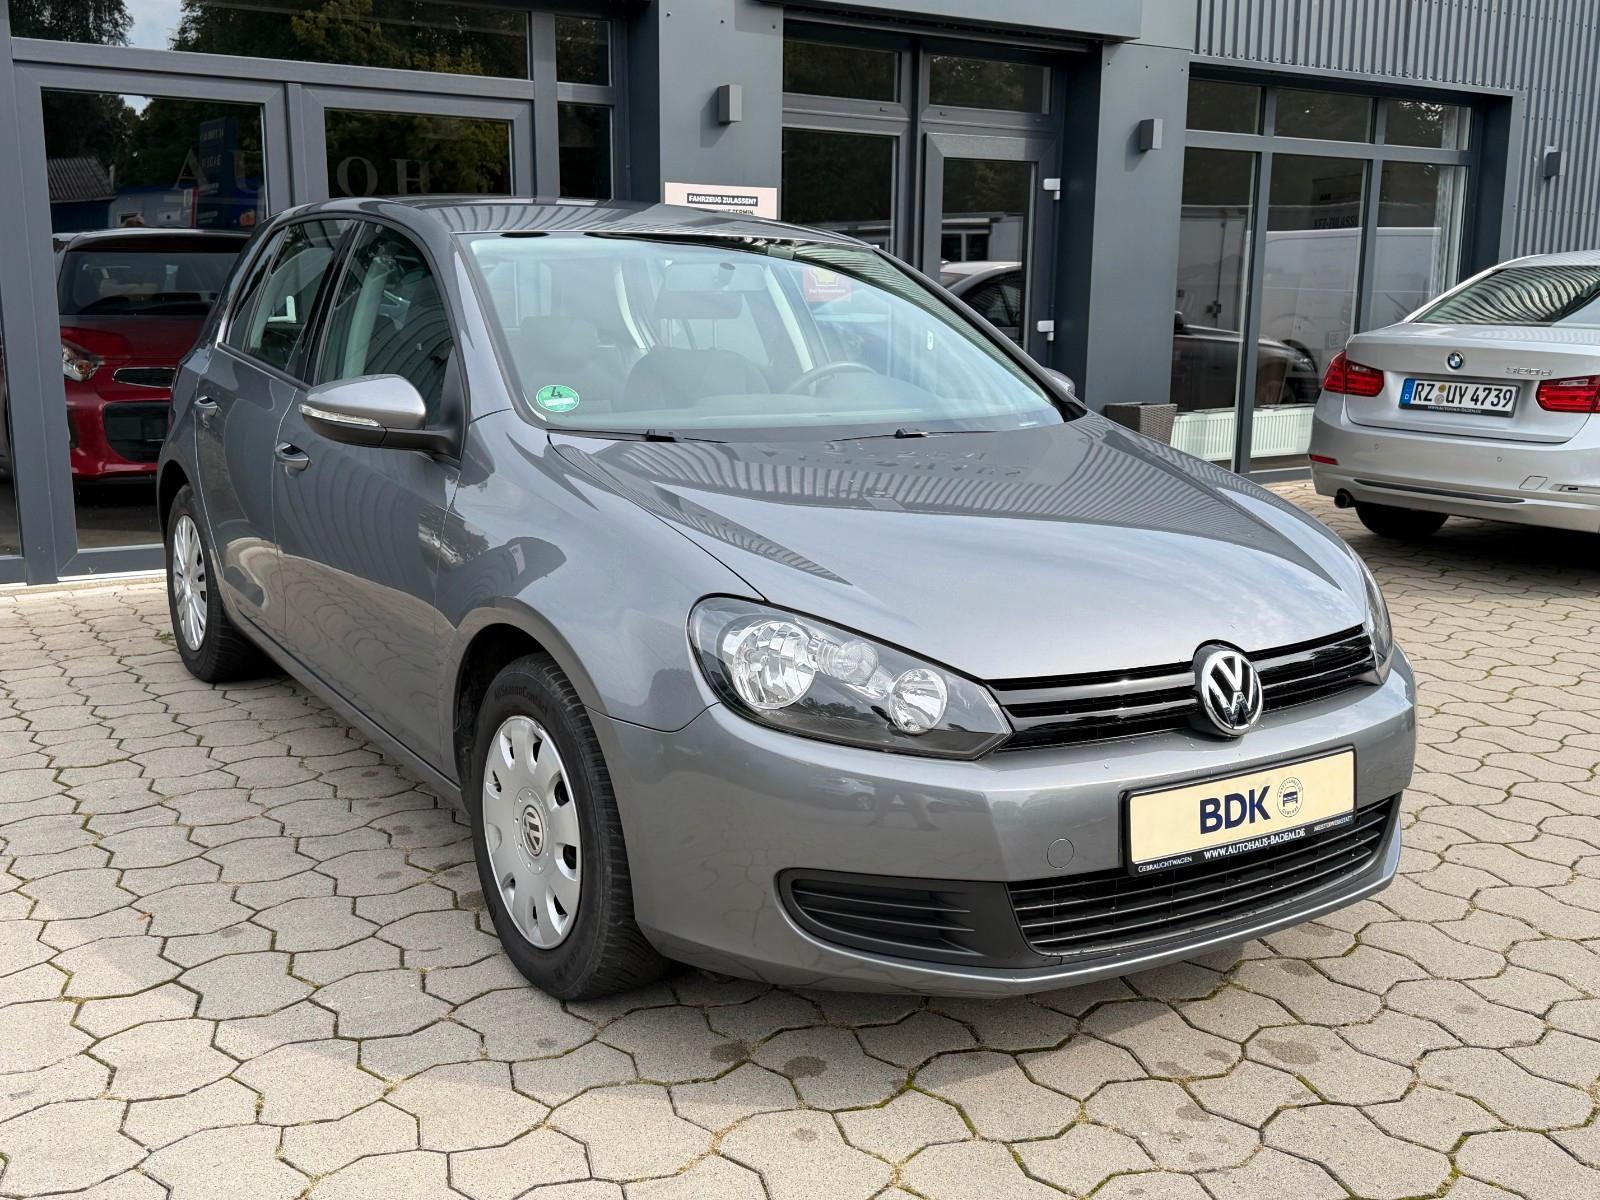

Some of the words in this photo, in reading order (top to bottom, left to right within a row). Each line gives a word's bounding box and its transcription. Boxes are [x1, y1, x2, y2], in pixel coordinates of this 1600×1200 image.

[688, 195, 722, 204] FAHRZEUG
[722, 196, 757, 205] ZULASSEN?
[551, 386, 562, 398] 4
[1413, 383, 1436, 402] RZ
[1446, 385, 1469, 404] UY
[1470, 387, 1514, 408] 4739
[1205, 653, 1259, 732] VW
[1199, 785, 1272, 835] BDK
[1204, 828, 1306, 860] WWW.AUTOHAUS-BADEM.DE
[1138, 856, 1193, 873] GEBRAUCHTWAGEN
